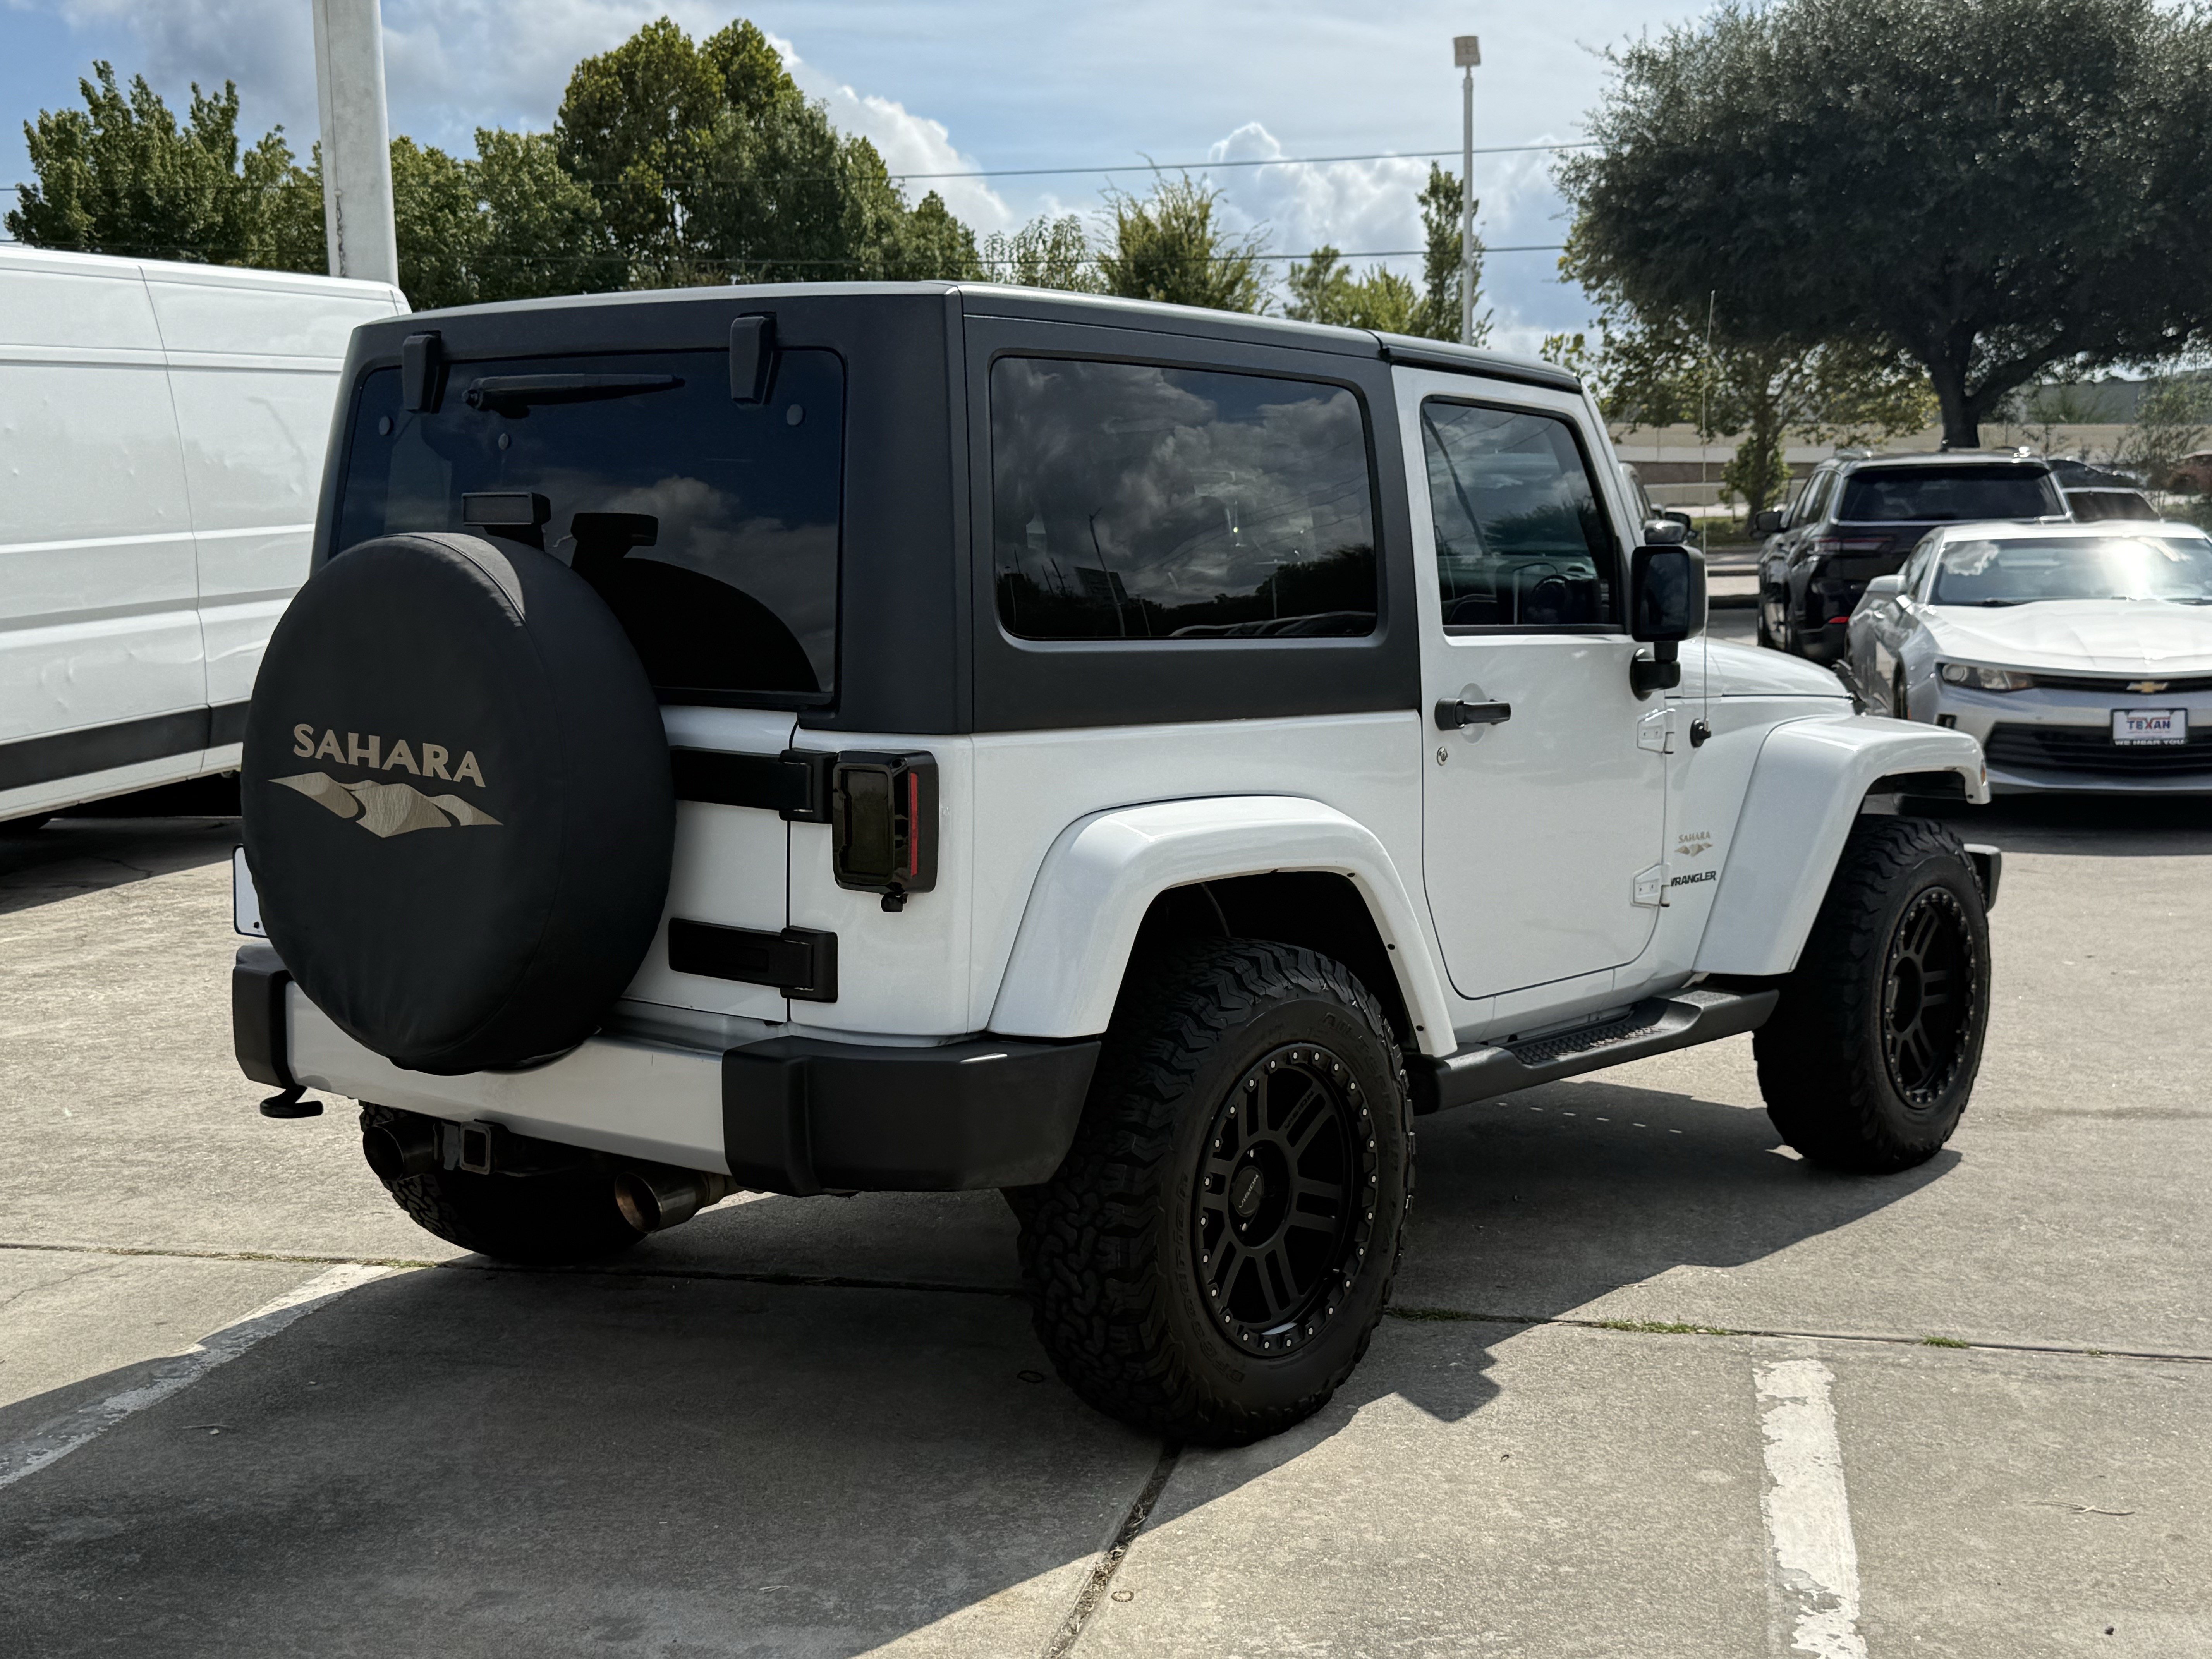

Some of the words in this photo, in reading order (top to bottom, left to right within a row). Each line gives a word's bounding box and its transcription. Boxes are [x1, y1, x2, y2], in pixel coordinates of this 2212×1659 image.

[2127, 718, 2171, 730] TEXAN
[293, 723, 486, 788] SAHARA
[1678, 831, 1711, 843] SAHARA
